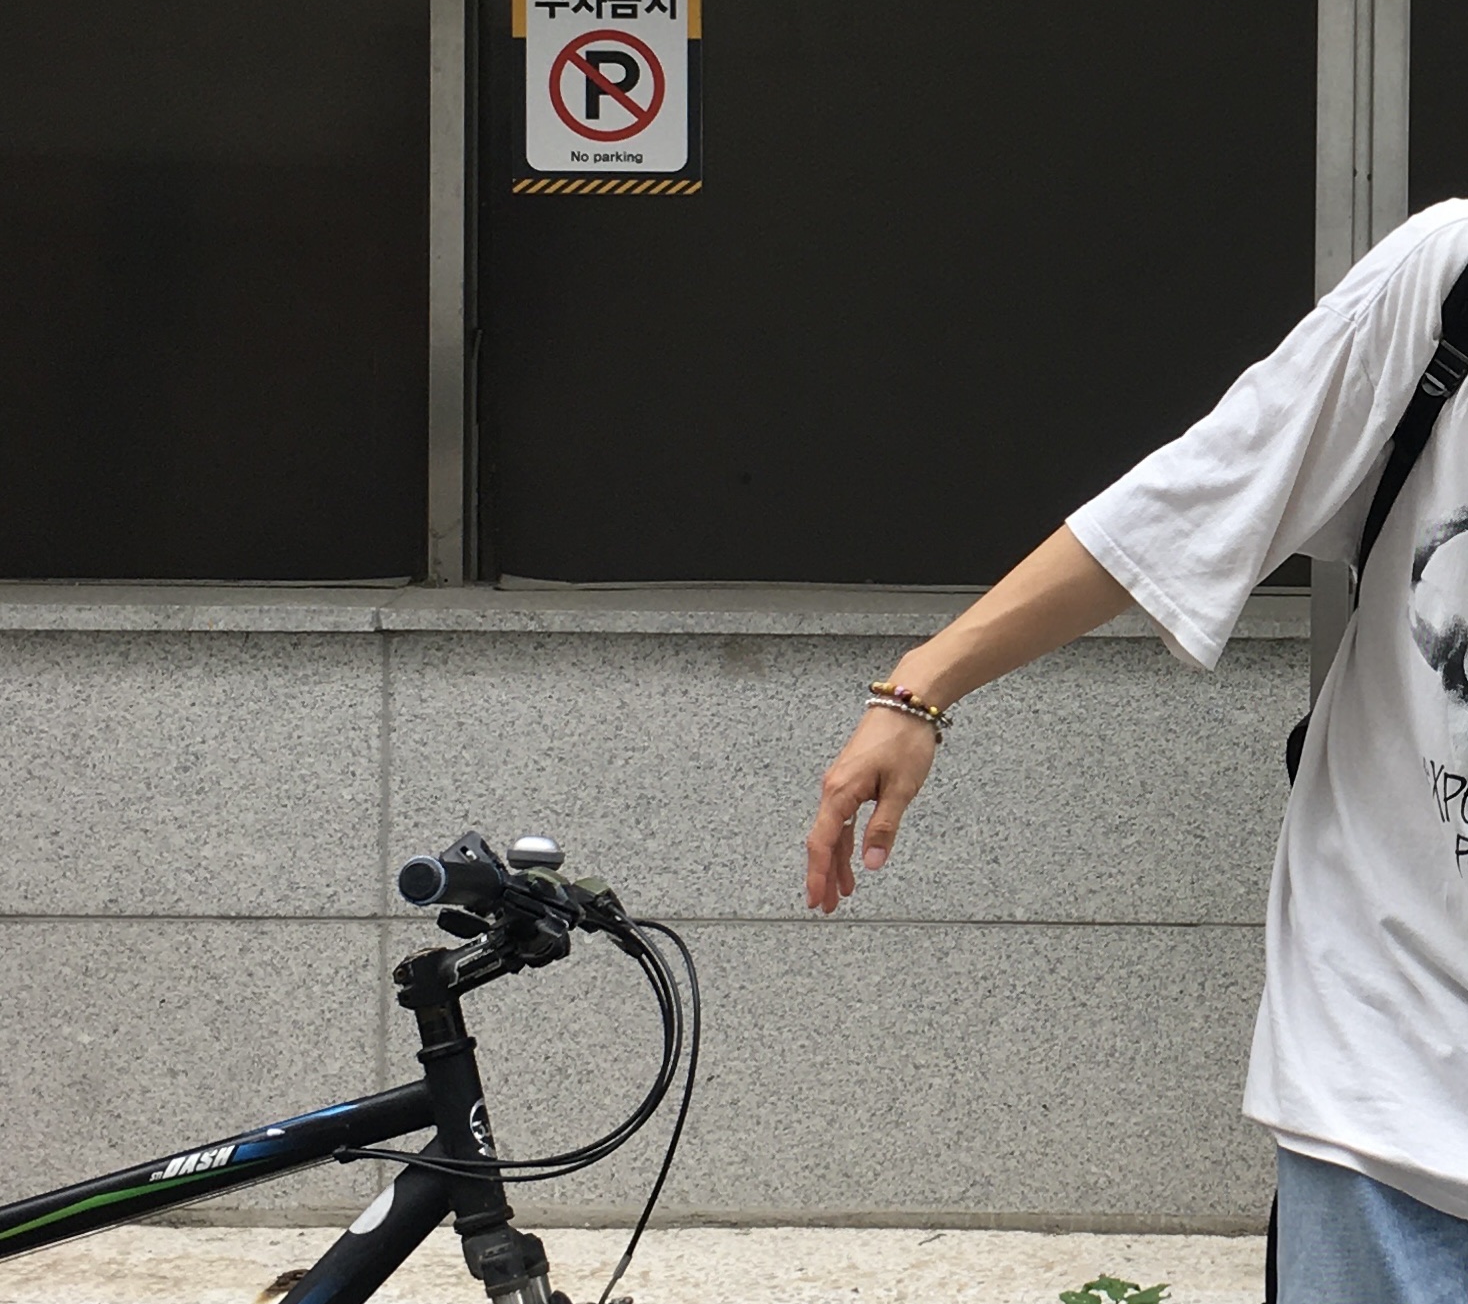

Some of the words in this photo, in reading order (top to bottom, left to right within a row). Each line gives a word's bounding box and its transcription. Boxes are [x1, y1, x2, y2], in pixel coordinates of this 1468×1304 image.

[571, 151, 589, 162] No
[593, 151, 643, 164] parking
[162, 1144, 236, 1180] DASH
